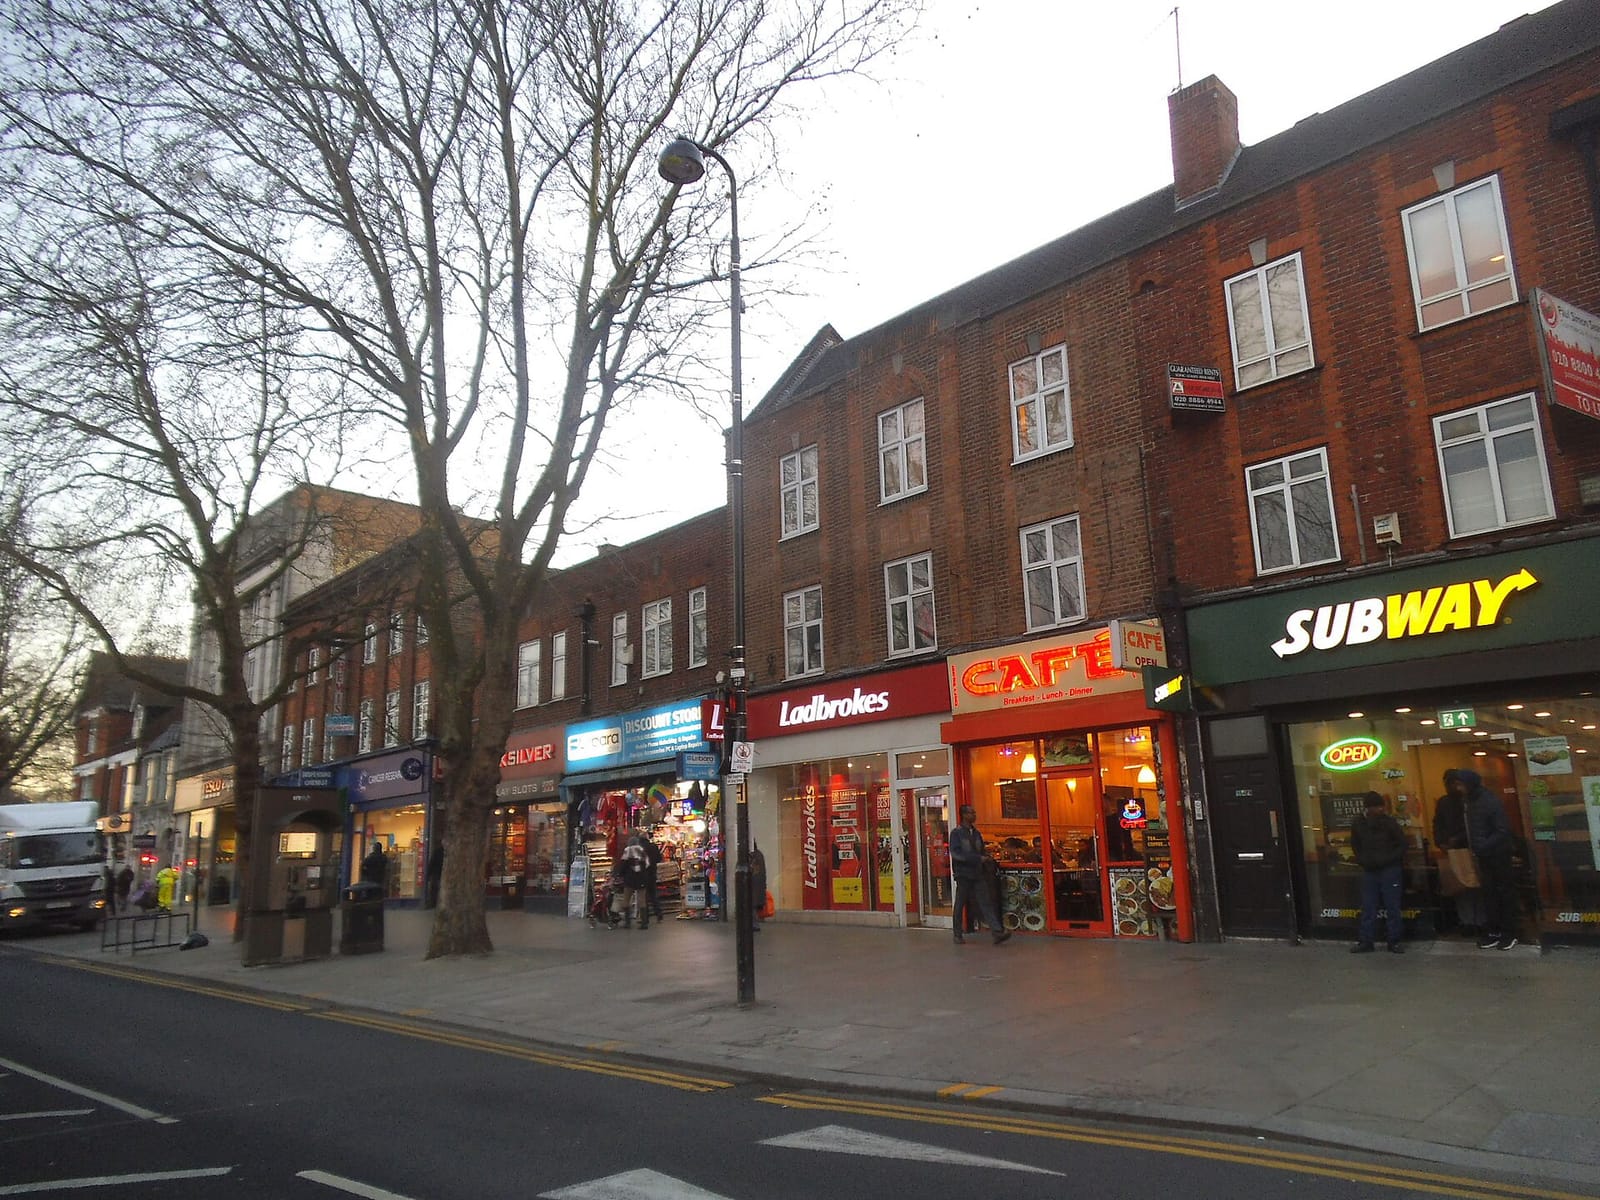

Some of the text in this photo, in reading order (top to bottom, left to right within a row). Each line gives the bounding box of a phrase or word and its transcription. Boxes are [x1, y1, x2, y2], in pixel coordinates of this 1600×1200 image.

[1576, 394, 1591, 412] TO
[1270, 568, 1538, 658] SUBWAY
[1135, 656, 1158, 667] OPEN
[1003, 687, 1093, 705] Breakfast Lunch Dinner
[779, 688, 889, 727] Ladbrokes
[625, 712, 671, 734] DISCOUNT
[1329, 744, 1375, 763] OPEN
[804, 785, 818, 889] Ladbrokes
[1556, 912, 1600, 923] SUBWA
